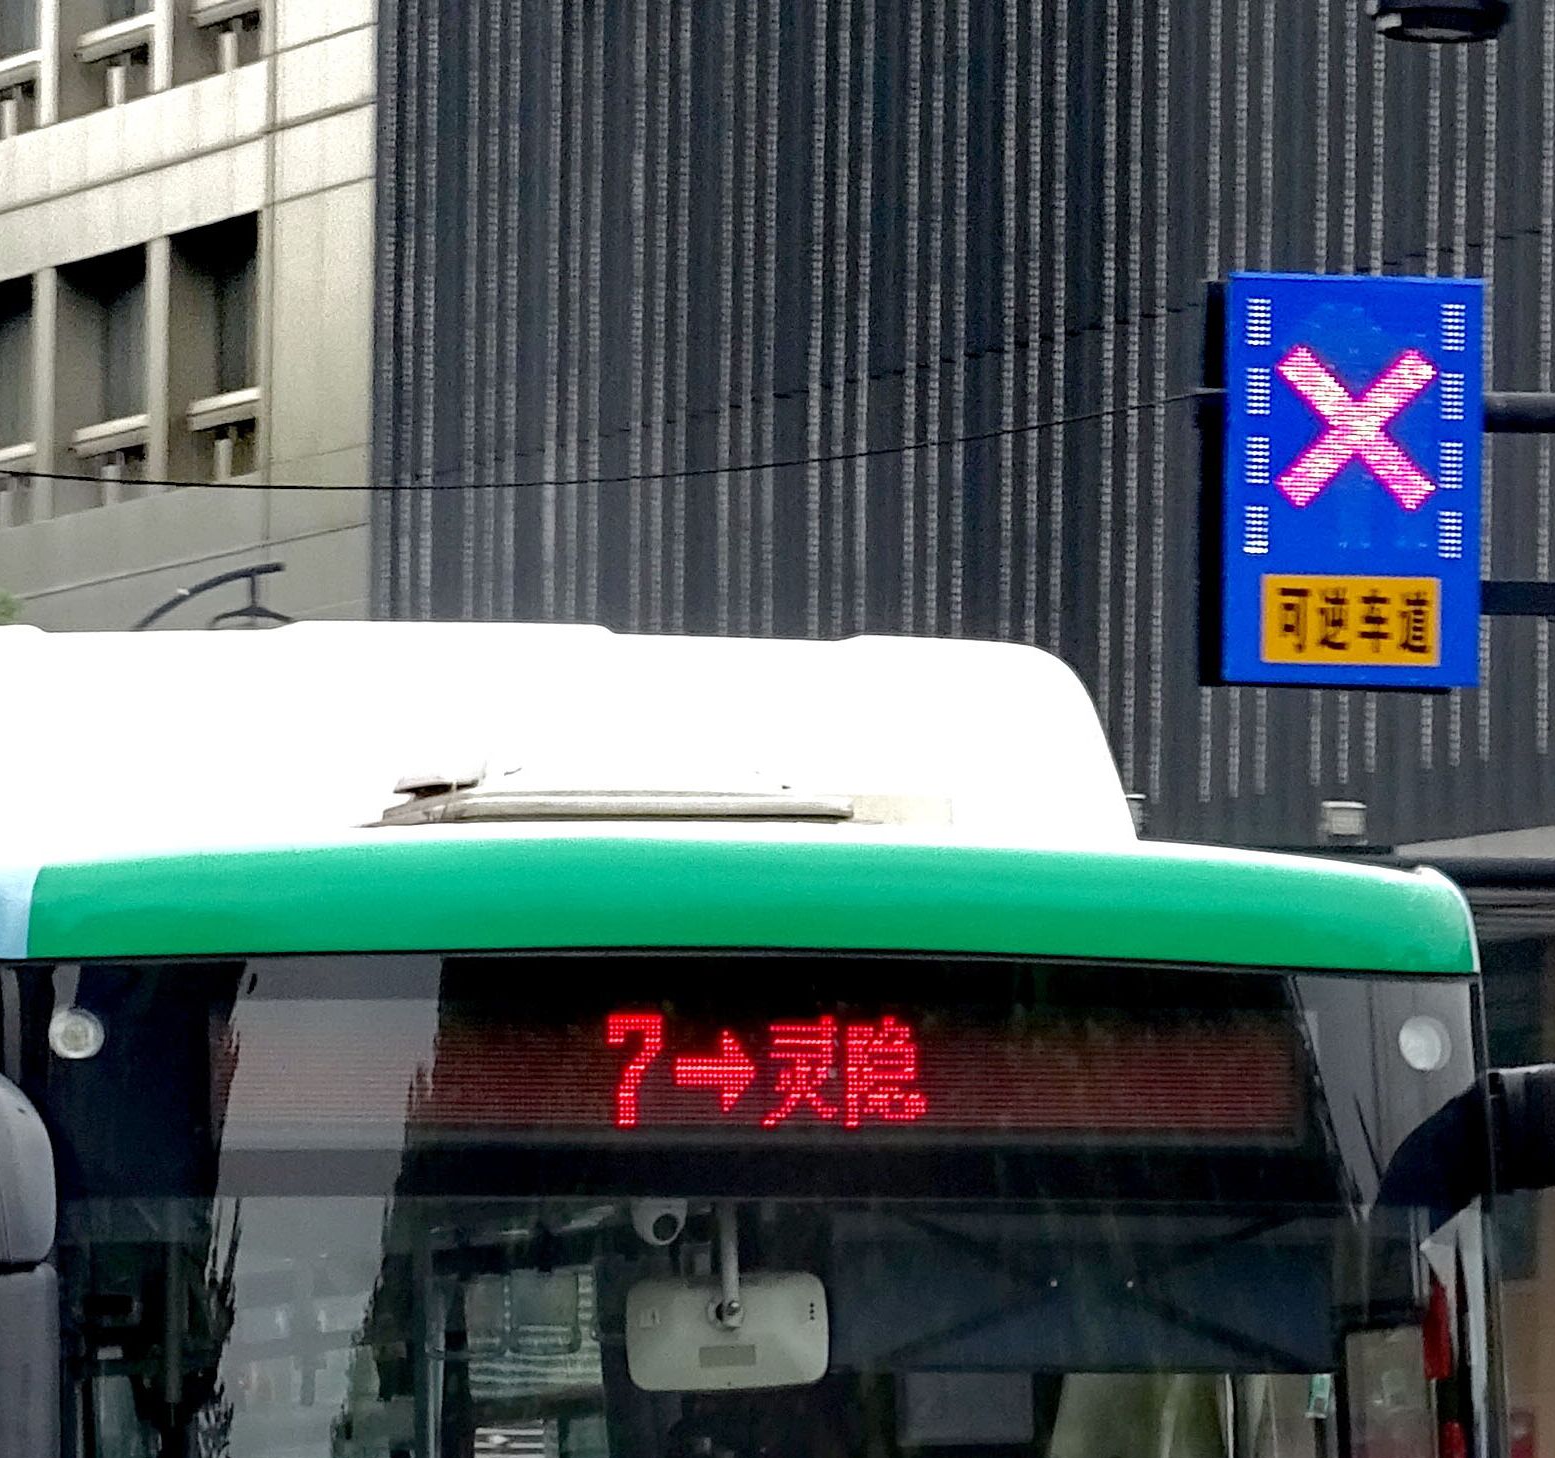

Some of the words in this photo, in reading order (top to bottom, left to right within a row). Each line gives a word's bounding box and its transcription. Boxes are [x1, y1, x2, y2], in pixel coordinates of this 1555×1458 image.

[1277, 587, 1431, 654] 可逆车道
[761, 1014, 928, 1128] 灵隐
